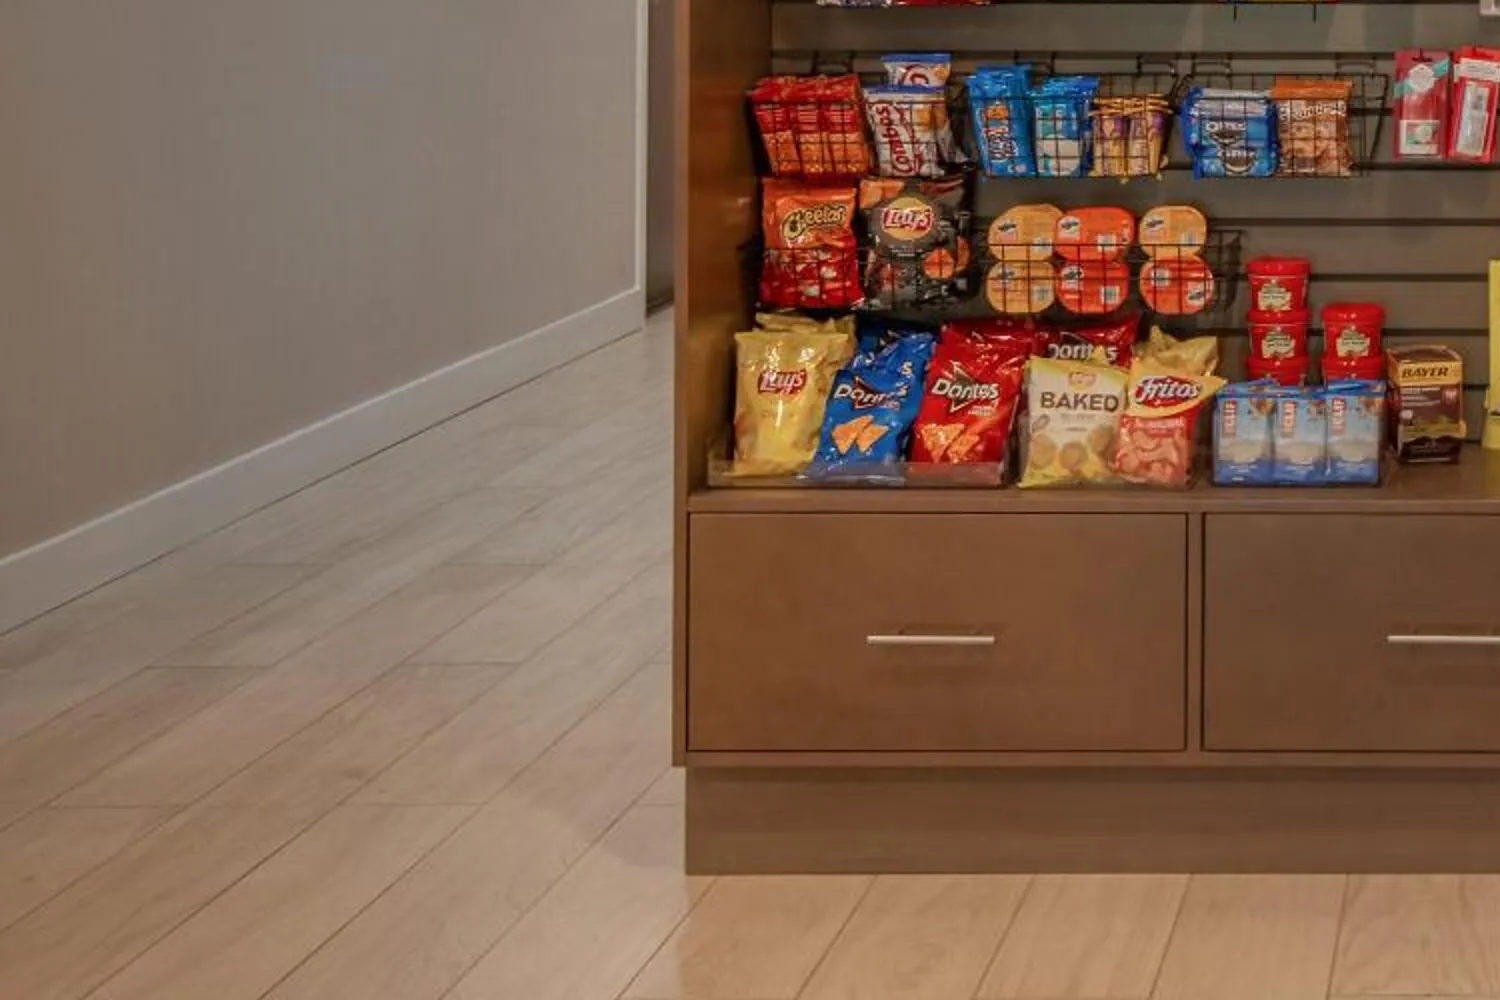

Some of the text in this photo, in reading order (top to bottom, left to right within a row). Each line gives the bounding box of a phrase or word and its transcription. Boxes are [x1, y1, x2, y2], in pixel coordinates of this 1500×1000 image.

[1402, 366, 1449, 379] BAYER
[1137, 375, 1201, 403] Fritos
[1040, 391, 1120, 413] BAKED
